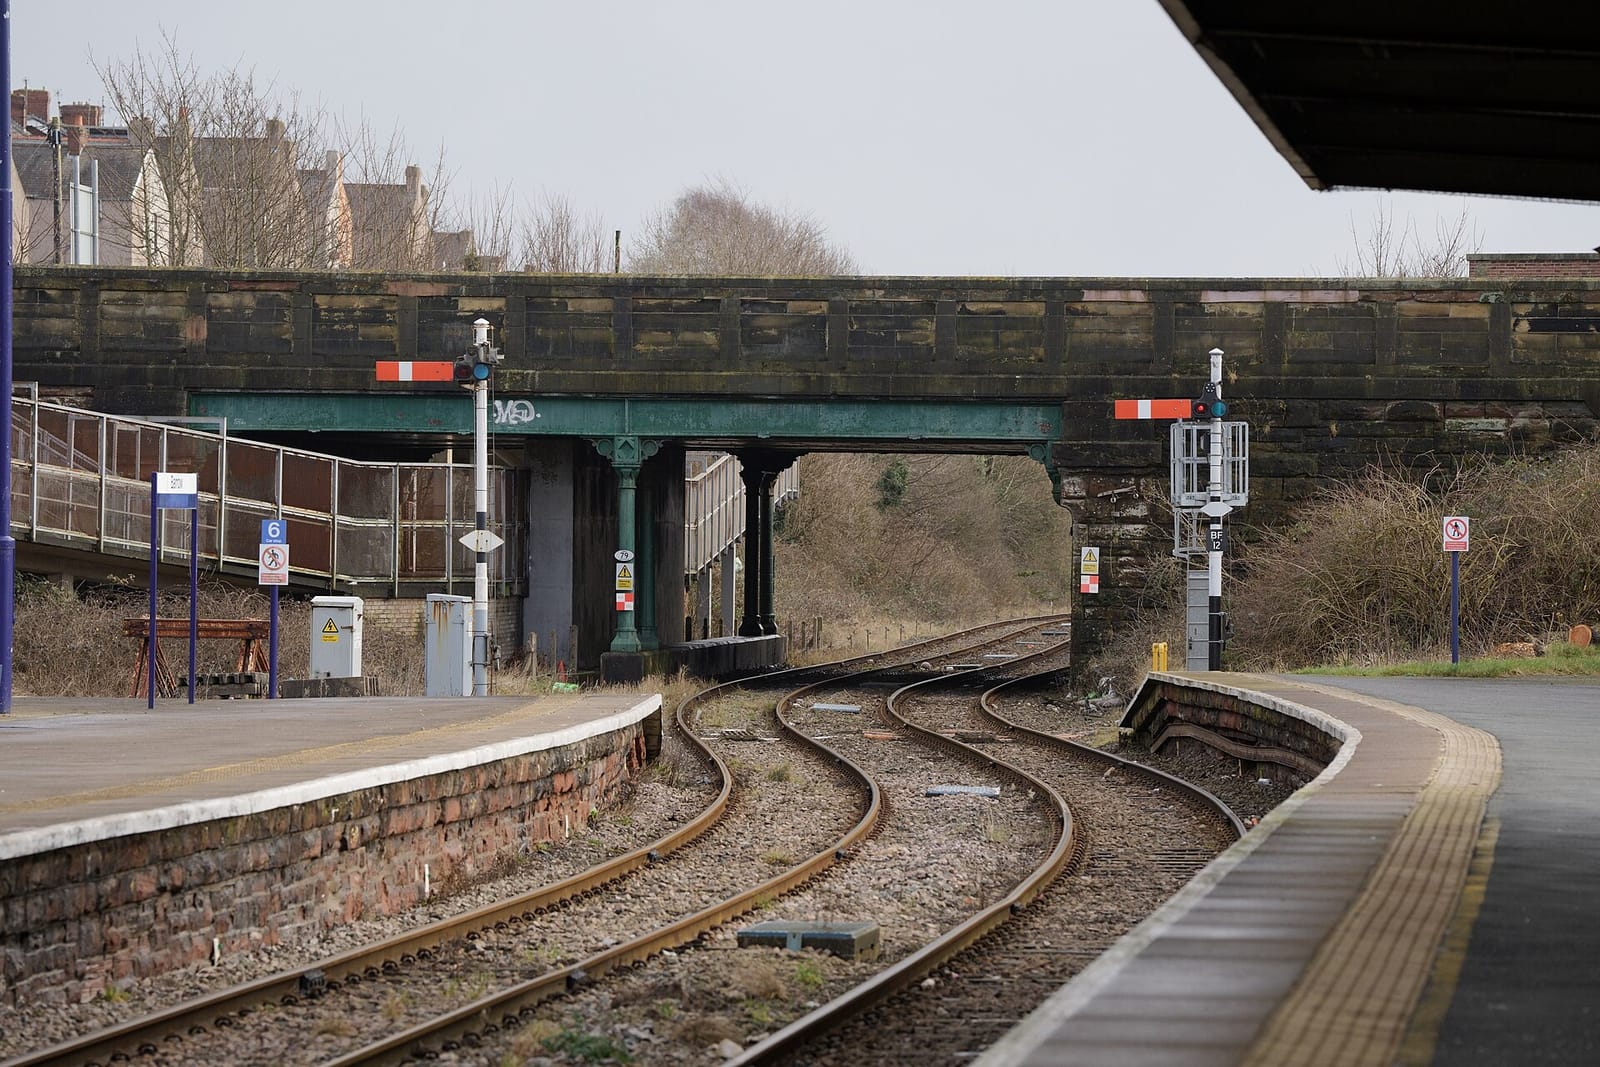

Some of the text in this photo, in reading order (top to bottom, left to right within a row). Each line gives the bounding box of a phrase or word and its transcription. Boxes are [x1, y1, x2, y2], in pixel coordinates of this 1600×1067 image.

[268, 522, 280, 538] 6
[1210, 531, 1223, 539] BF
[1213, 541, 1221, 549] 12
